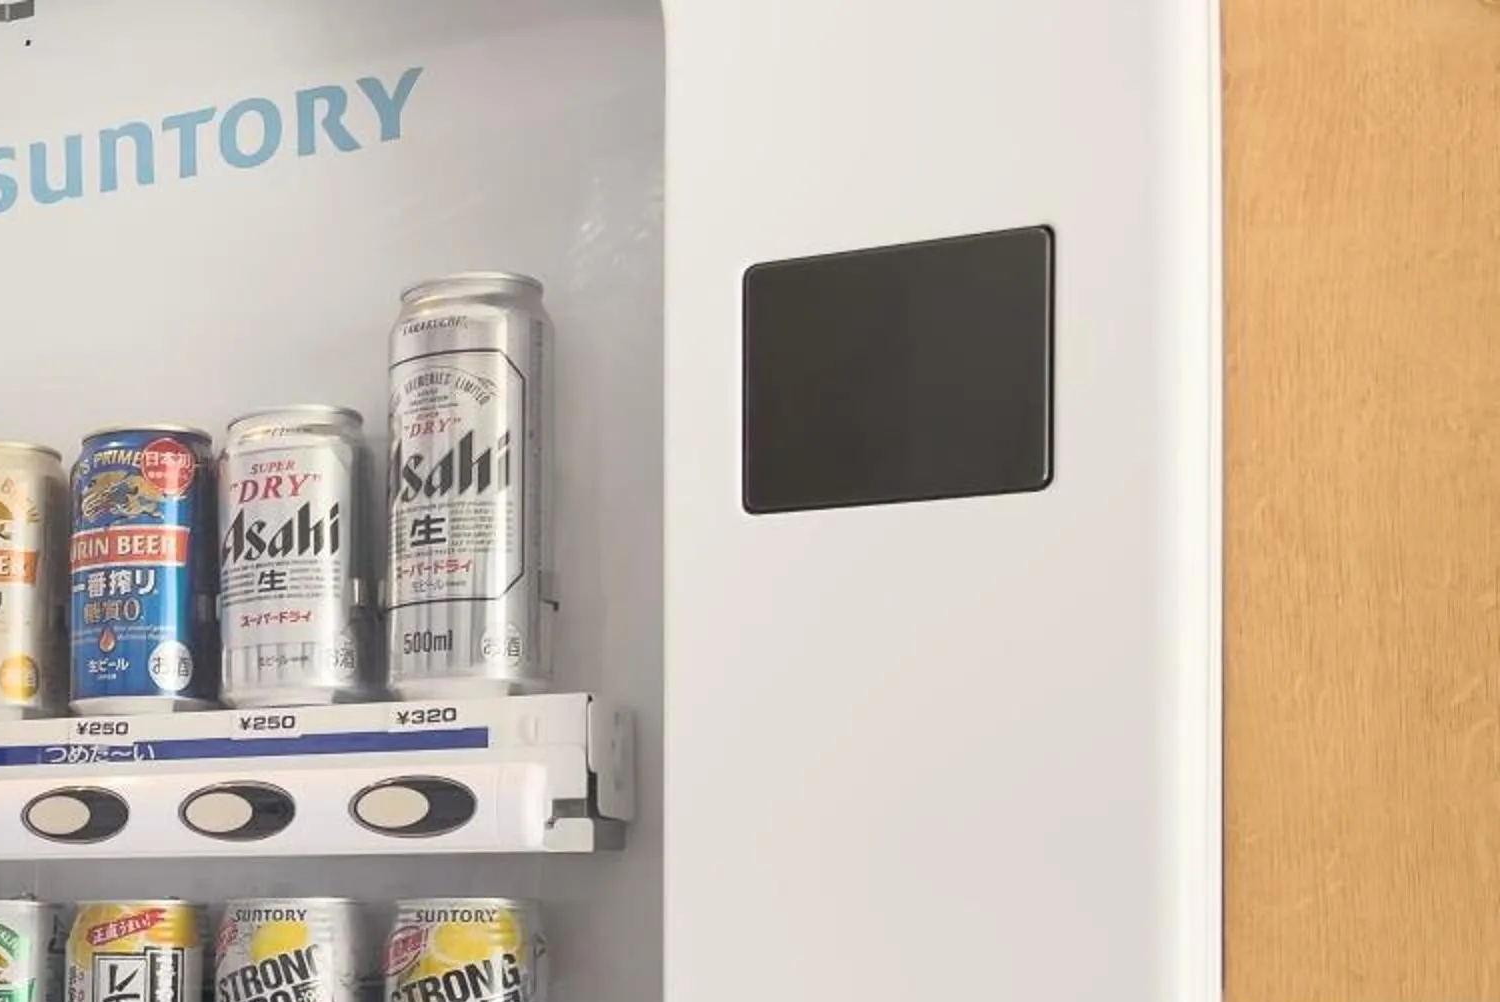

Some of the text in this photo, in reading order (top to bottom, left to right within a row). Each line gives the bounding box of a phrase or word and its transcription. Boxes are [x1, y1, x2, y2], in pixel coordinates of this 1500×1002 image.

[249, 460, 296, 475] SUPER
[221, 501, 340, 567] Asahi
[410, 514, 447, 547] 生
[72, 569, 157, 596] 一番搾り
[257, 568, 288, 593] 生
[240, 610, 314, 629] スーパードライ
[403, 629, 454, 655] 500ml
[240, 714, 297, 732] ¥250
[396, 707, 458, 726] ¥320
[76, 720, 130, 737] ¥250
[233, 908, 308, 922] SUNTORY
[414, 908, 498, 924] SUNTORY
